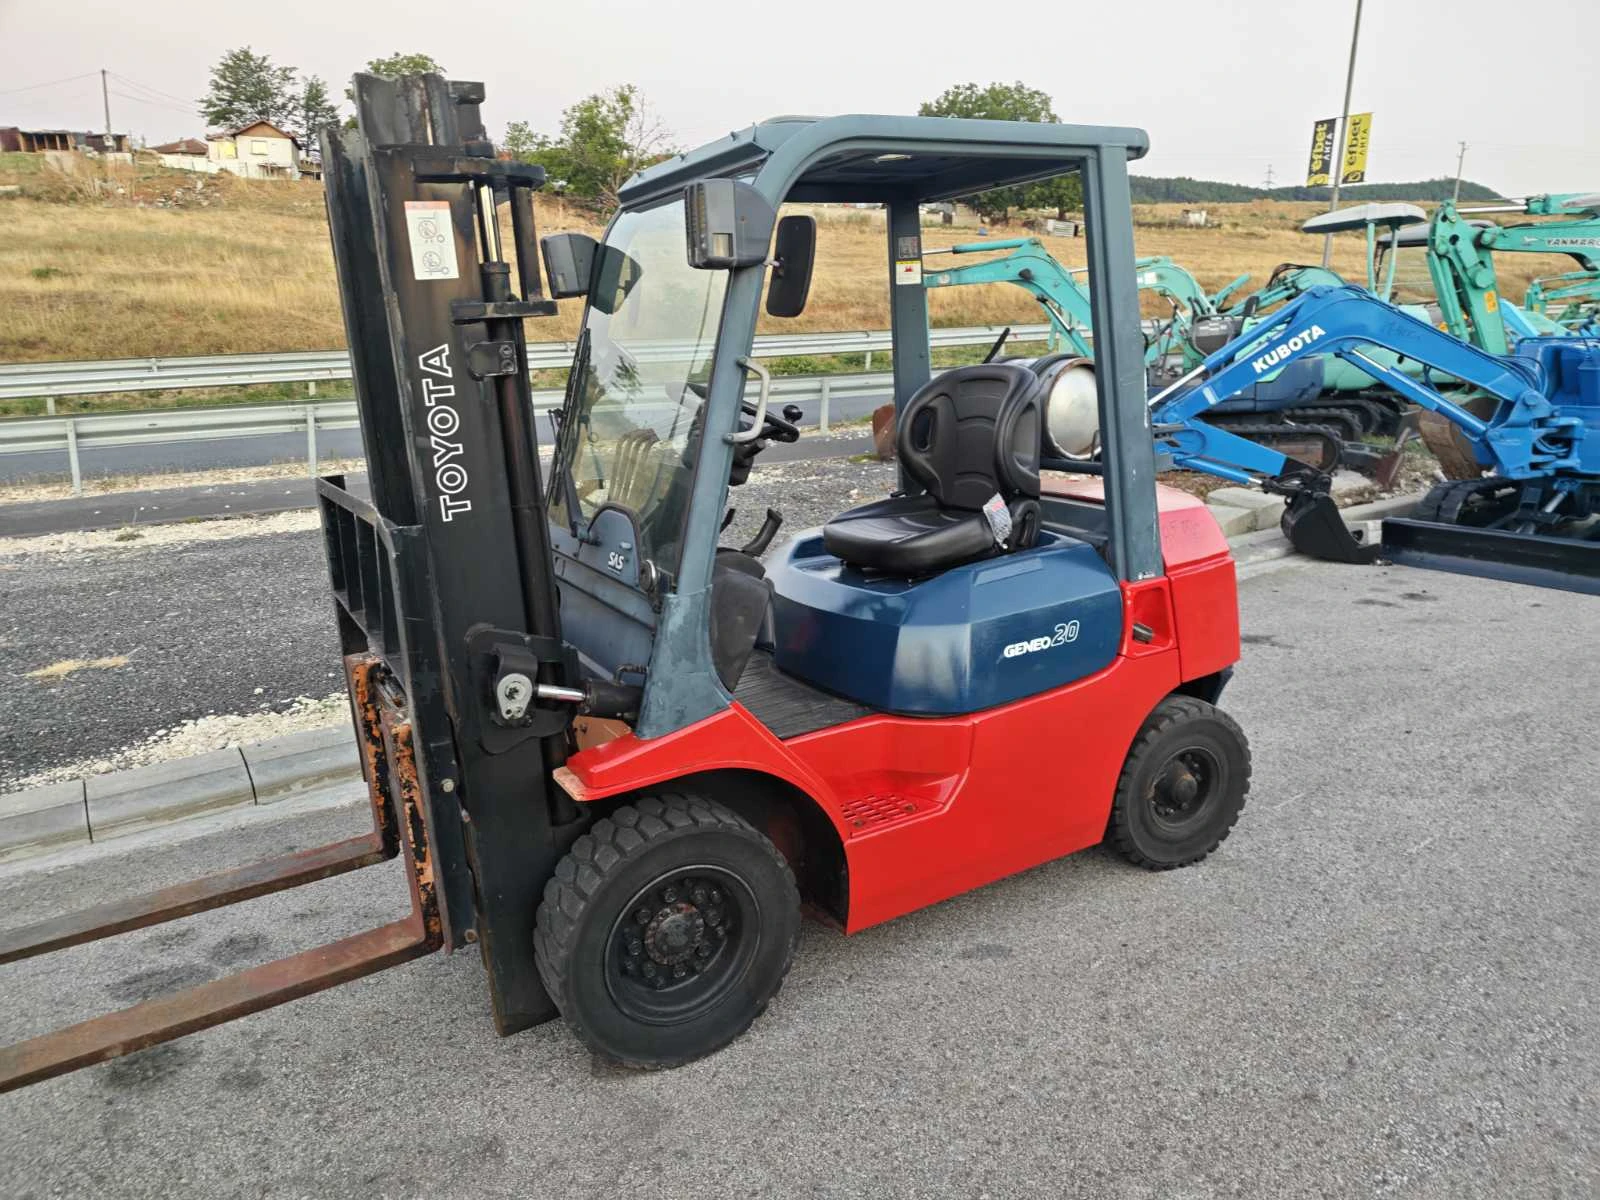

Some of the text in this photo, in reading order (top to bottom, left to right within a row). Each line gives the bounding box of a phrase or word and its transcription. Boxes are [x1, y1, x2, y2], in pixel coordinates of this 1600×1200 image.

[1311, 122, 1328, 171] efbet
[1347, 119, 1361, 166] efbet
[1547, 238, 1595, 247] YANMAR
[1252, 325, 1326, 373] KUBOTA
[419, 344, 471, 522] TOYOTA
[608, 552, 624, 569] SAS
[1003, 620, 1080, 658] GENEO 20
